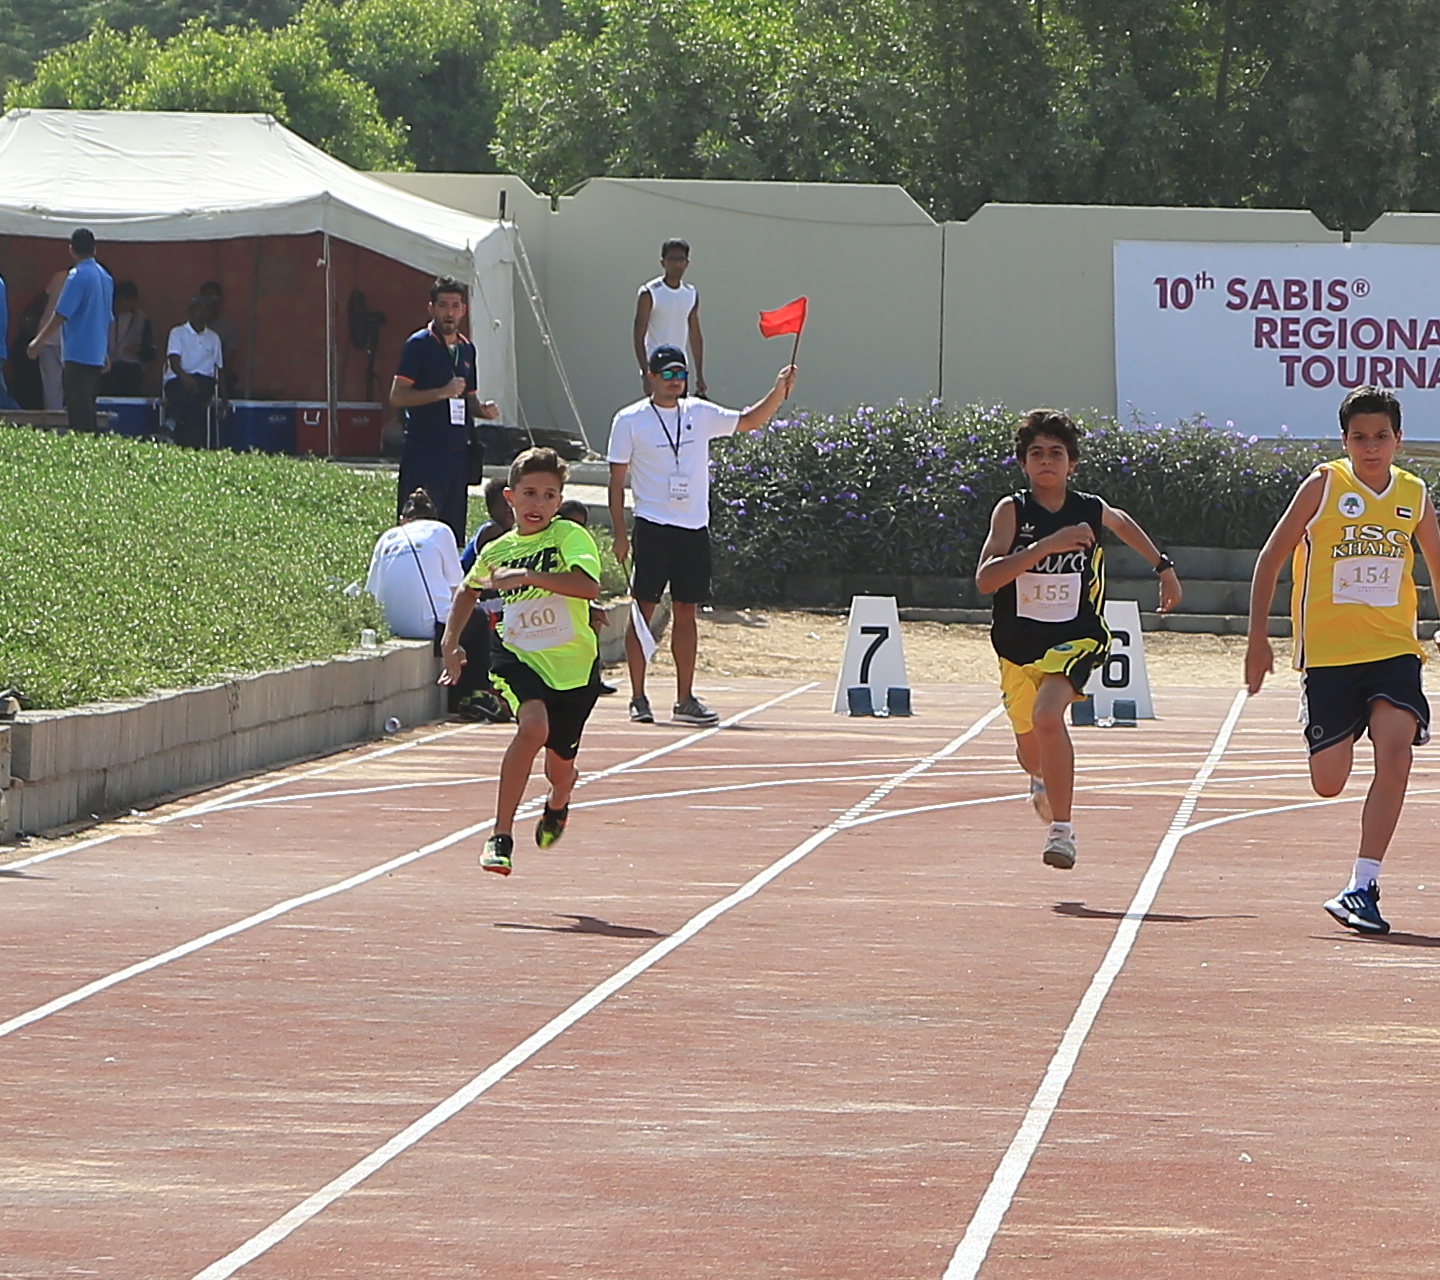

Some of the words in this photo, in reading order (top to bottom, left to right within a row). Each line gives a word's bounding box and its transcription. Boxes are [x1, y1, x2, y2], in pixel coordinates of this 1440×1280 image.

[1154, 271, 1215, 310] 10th
[1342, 524, 1410, 546] ISC
[1352, 566, 1391, 584] 154
[1033, 584, 1071, 601] 155
[516, 607, 556, 629] 160
[860, 626, 890, 684] 7
[1102, 631, 1130, 688] 6
